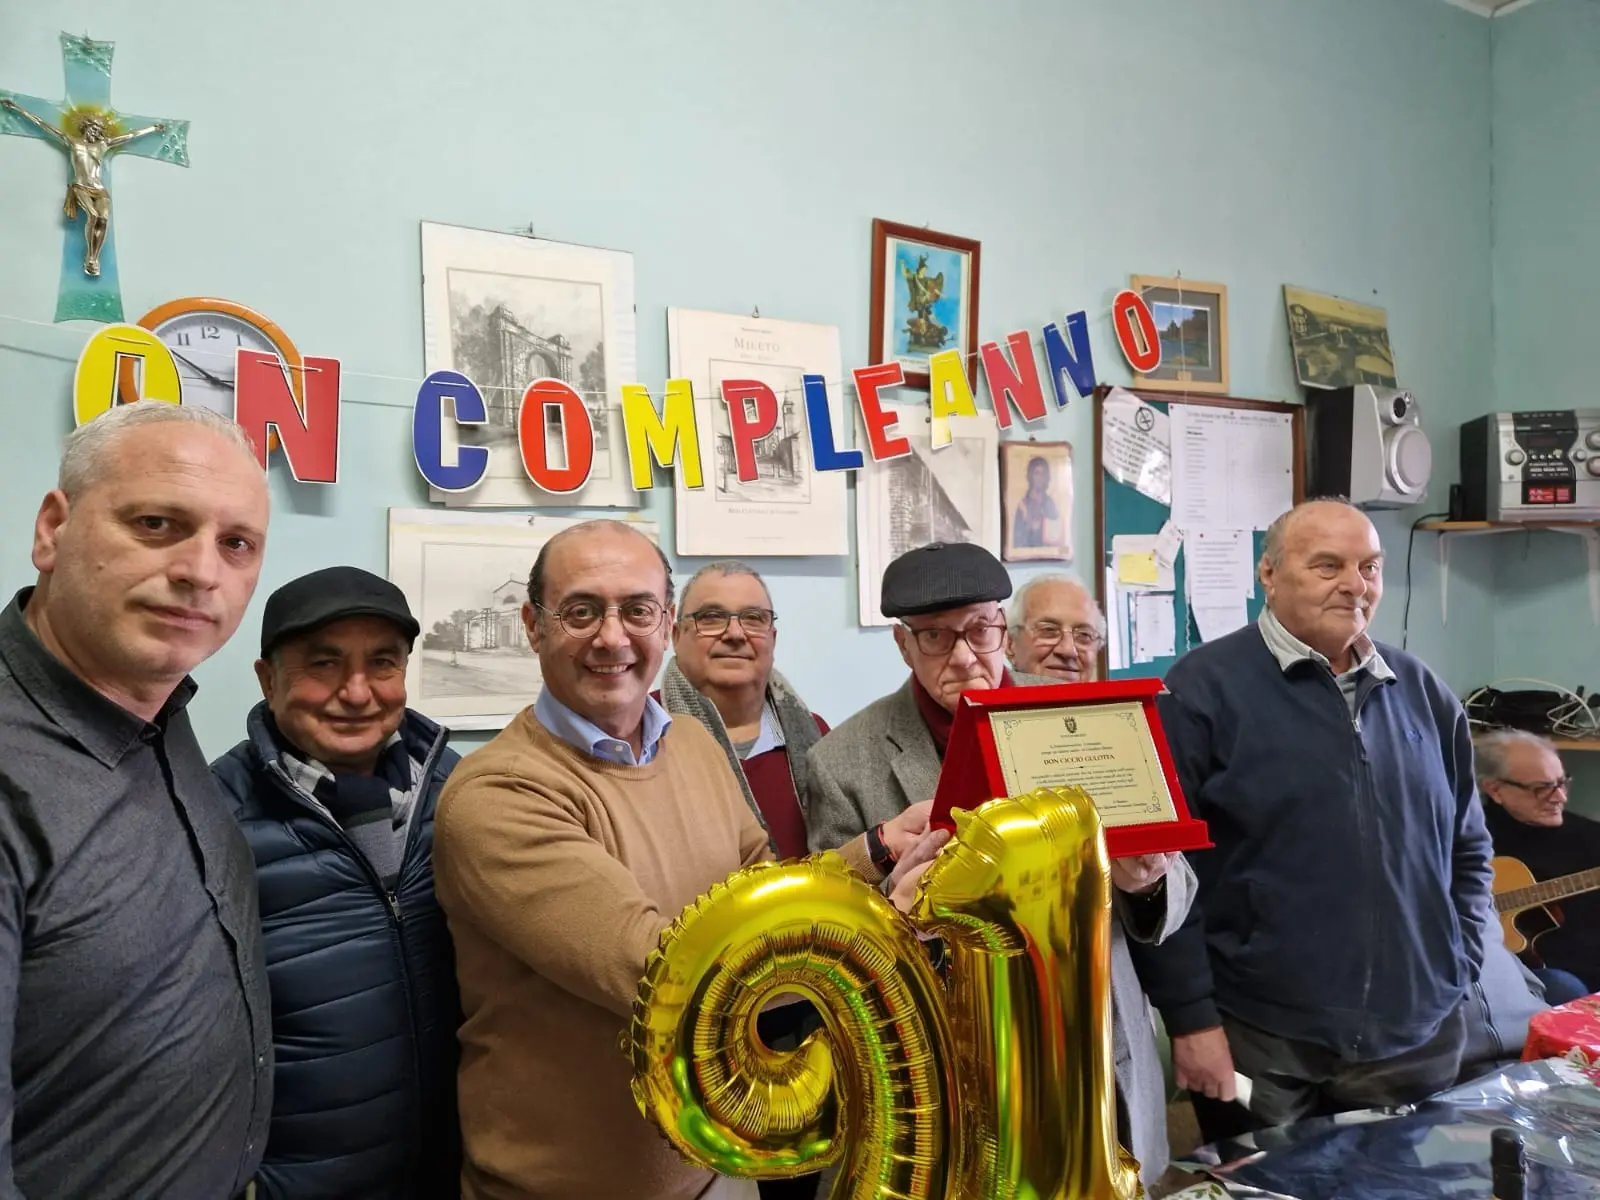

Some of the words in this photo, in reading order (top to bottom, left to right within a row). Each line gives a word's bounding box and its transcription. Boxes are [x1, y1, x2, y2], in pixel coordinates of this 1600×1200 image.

[176, 333, 191, 346] 11
[200, 326, 221, 340] 12
[236, 333, 243, 346] 1
[412, 288, 1163, 495] COMPLEANNO
[1043, 758, 1059, 766] DON
